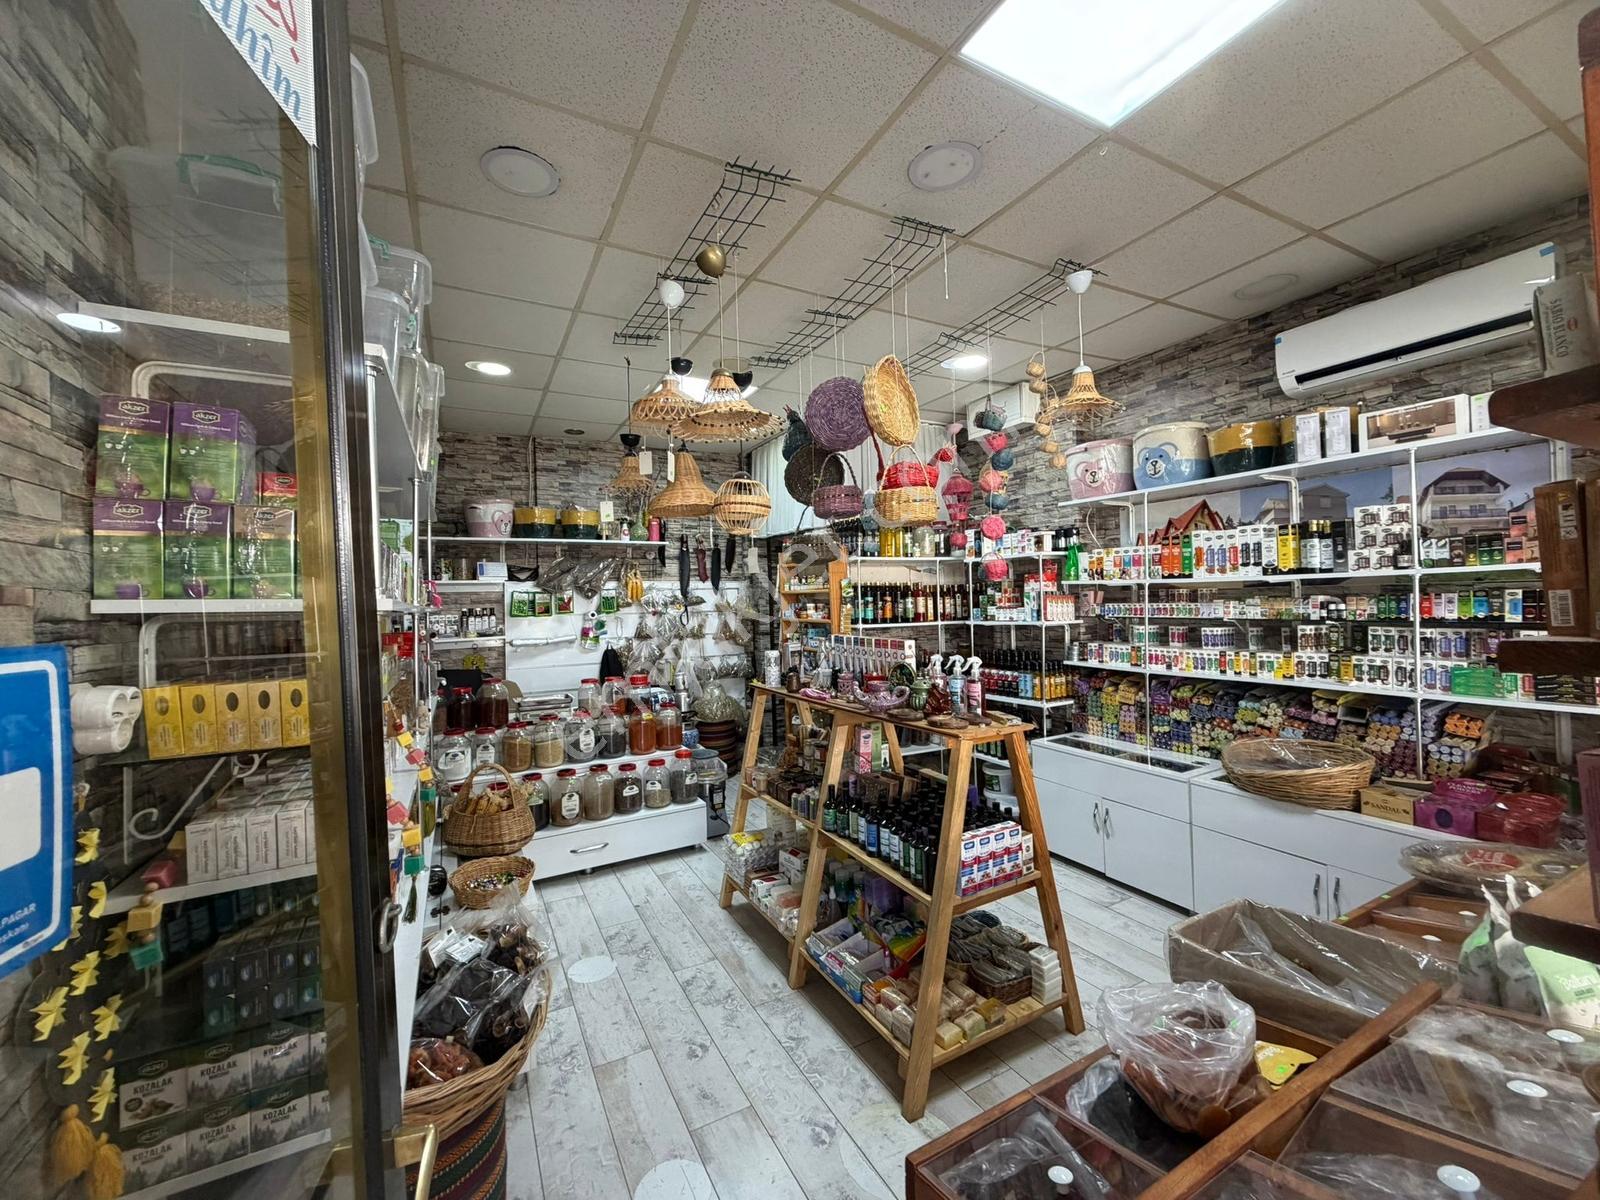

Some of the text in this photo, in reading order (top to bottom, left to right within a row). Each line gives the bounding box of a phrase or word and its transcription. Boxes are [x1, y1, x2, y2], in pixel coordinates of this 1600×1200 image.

[1370, 802, 1400, 815] SANDAL
[200, 1059, 238, 1078] KOZALAK
[133, 1076, 174, 1095] KOZALAK
[262, 1102, 298, 1121] KOZALAK
[199, 1123, 237, 1142] KOZALAK
[131, 1144, 173, 1162] KOZALAK
